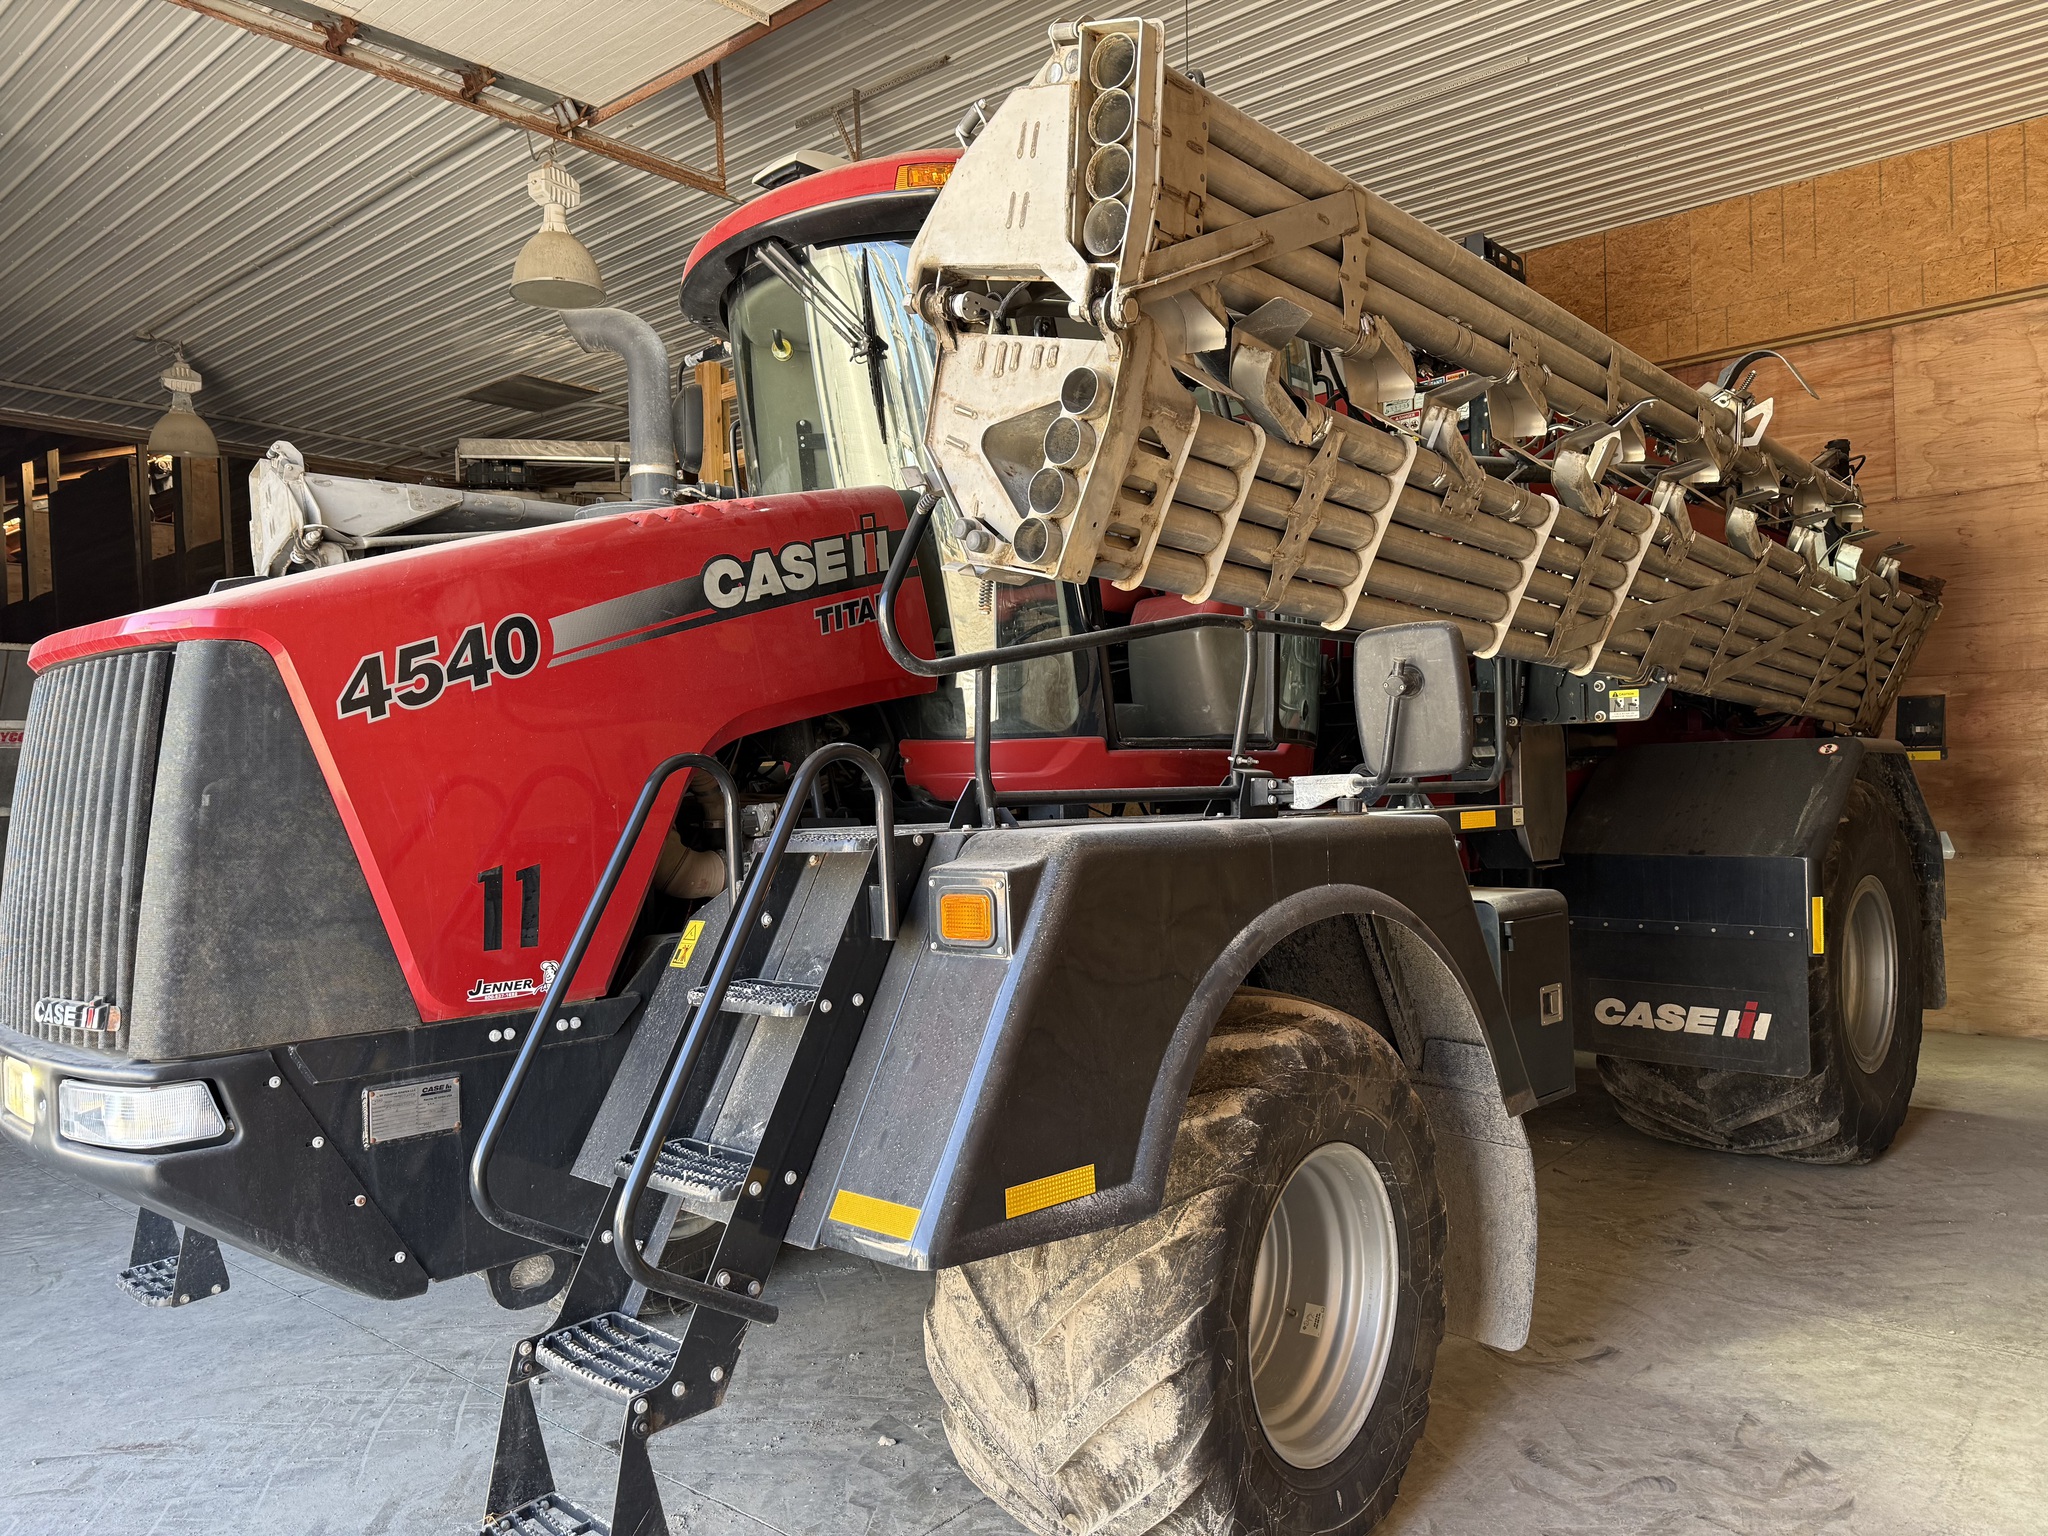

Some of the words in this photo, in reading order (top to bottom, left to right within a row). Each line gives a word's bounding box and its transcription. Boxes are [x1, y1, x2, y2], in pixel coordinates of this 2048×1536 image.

[703, 537, 848, 609] CASE
[814, 592, 880, 635] TITA
[336, 613, 541, 724] 4540
[478, 863, 541, 951] 11
[468, 979, 533, 996] JENNER
[35, 1001, 77, 1027] CASE
[1594, 997, 1720, 1036] CASE
[422, 1085, 444, 1093] CASE
